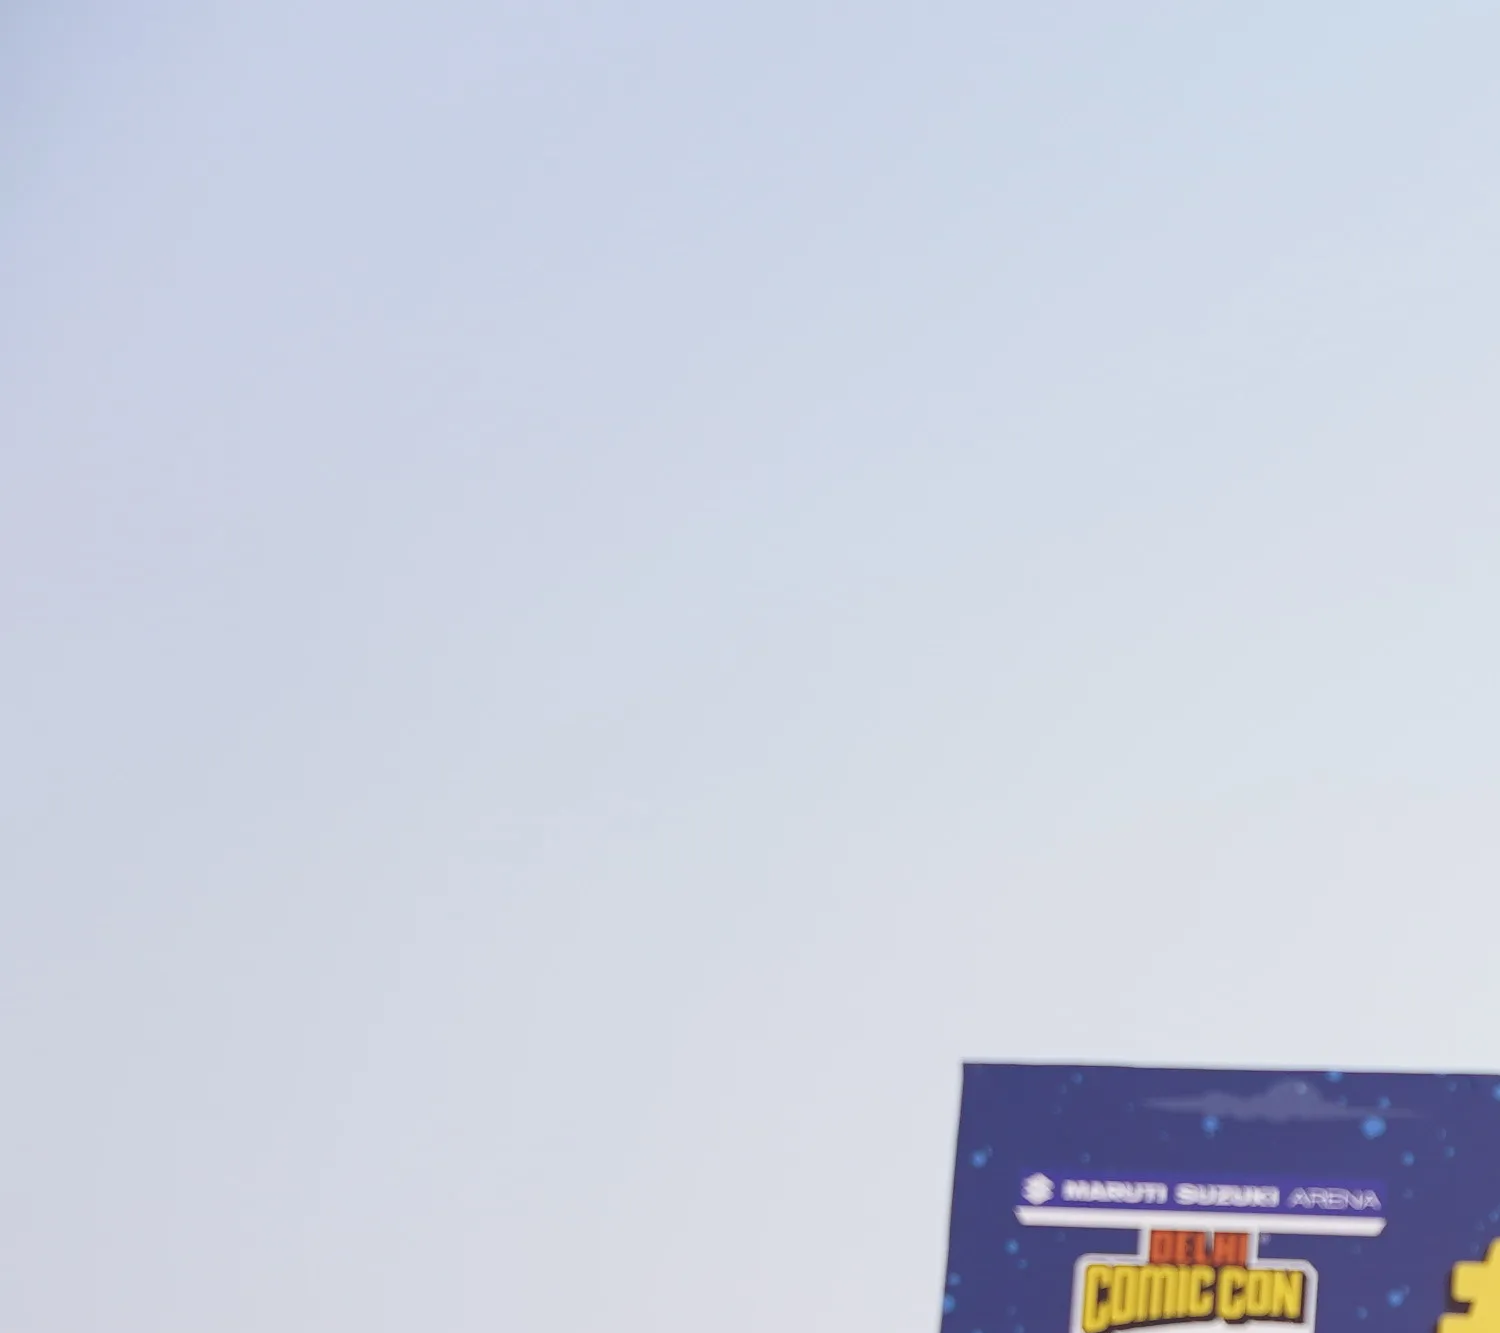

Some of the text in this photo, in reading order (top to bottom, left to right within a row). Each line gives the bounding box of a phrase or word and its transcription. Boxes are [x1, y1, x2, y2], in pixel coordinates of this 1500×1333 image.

[1061, 1179, 1382, 1211] MARUTI SUZUKI ARENA
[1150, 1230, 1249, 1267] DELHI
[1216, 1266, 1304, 1324] CON
